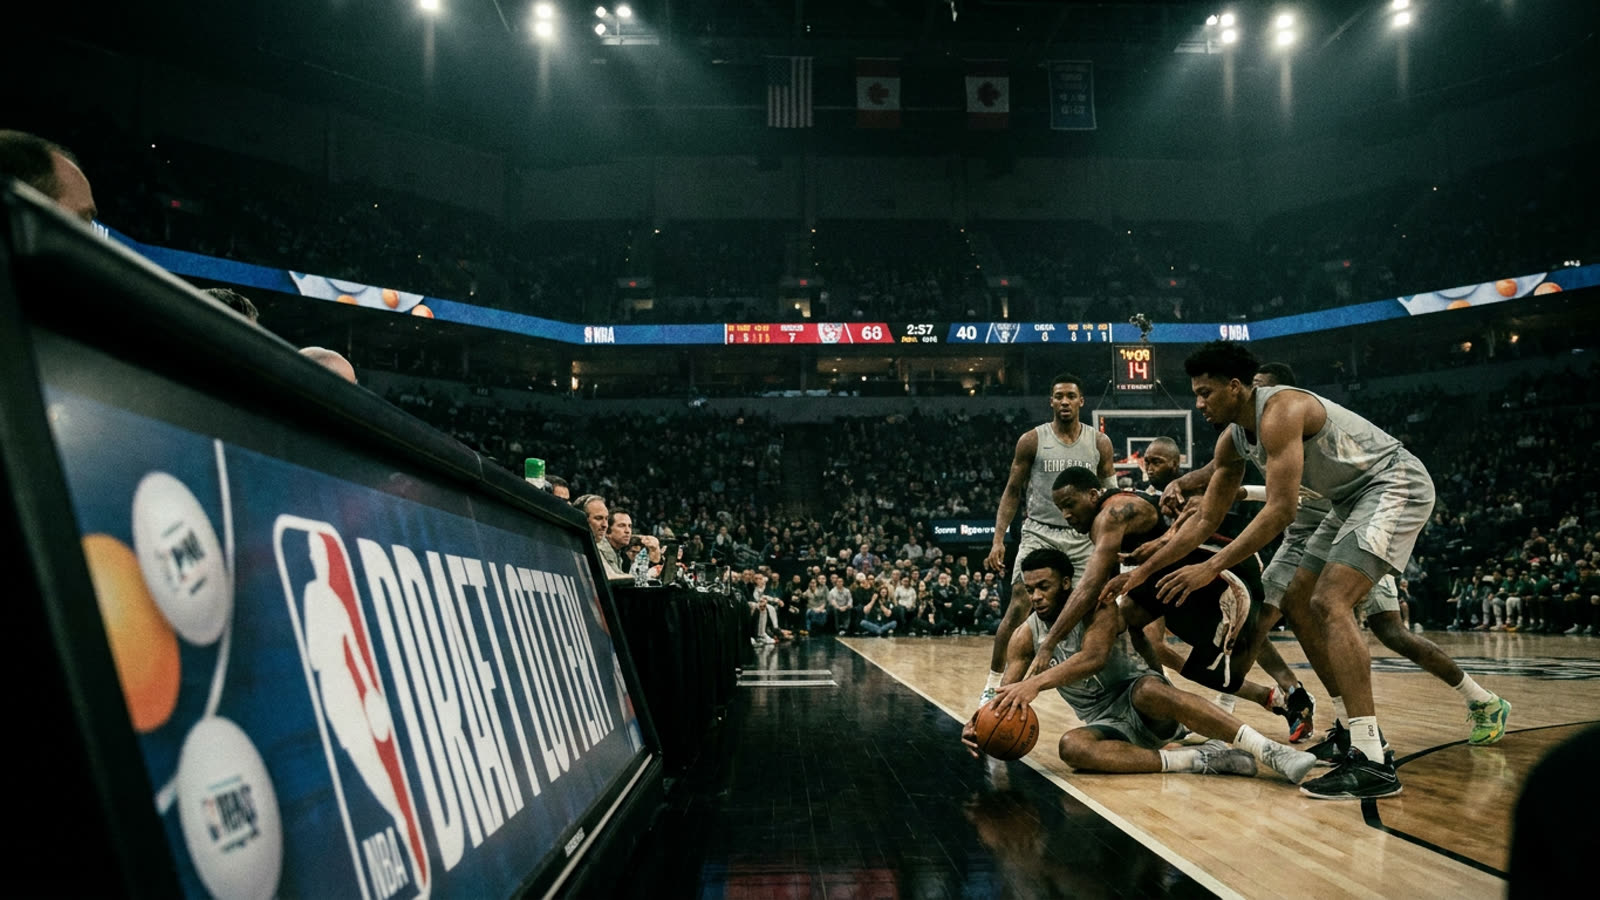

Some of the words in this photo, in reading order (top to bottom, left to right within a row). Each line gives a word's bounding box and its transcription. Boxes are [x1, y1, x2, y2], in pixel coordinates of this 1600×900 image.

[788, 332, 796, 343] 7
[861, 325, 883, 341] 68
[906, 324, 934, 335] 2:57
[956, 325, 977, 340] 40
[1229, 324, 1250, 341] NBA
[1129, 361, 1148, 380] 14
[357, 538, 541, 872] DRAFT
[488, 561, 615, 784] LOTTERY
[362, 826, 409, 900] NBA
